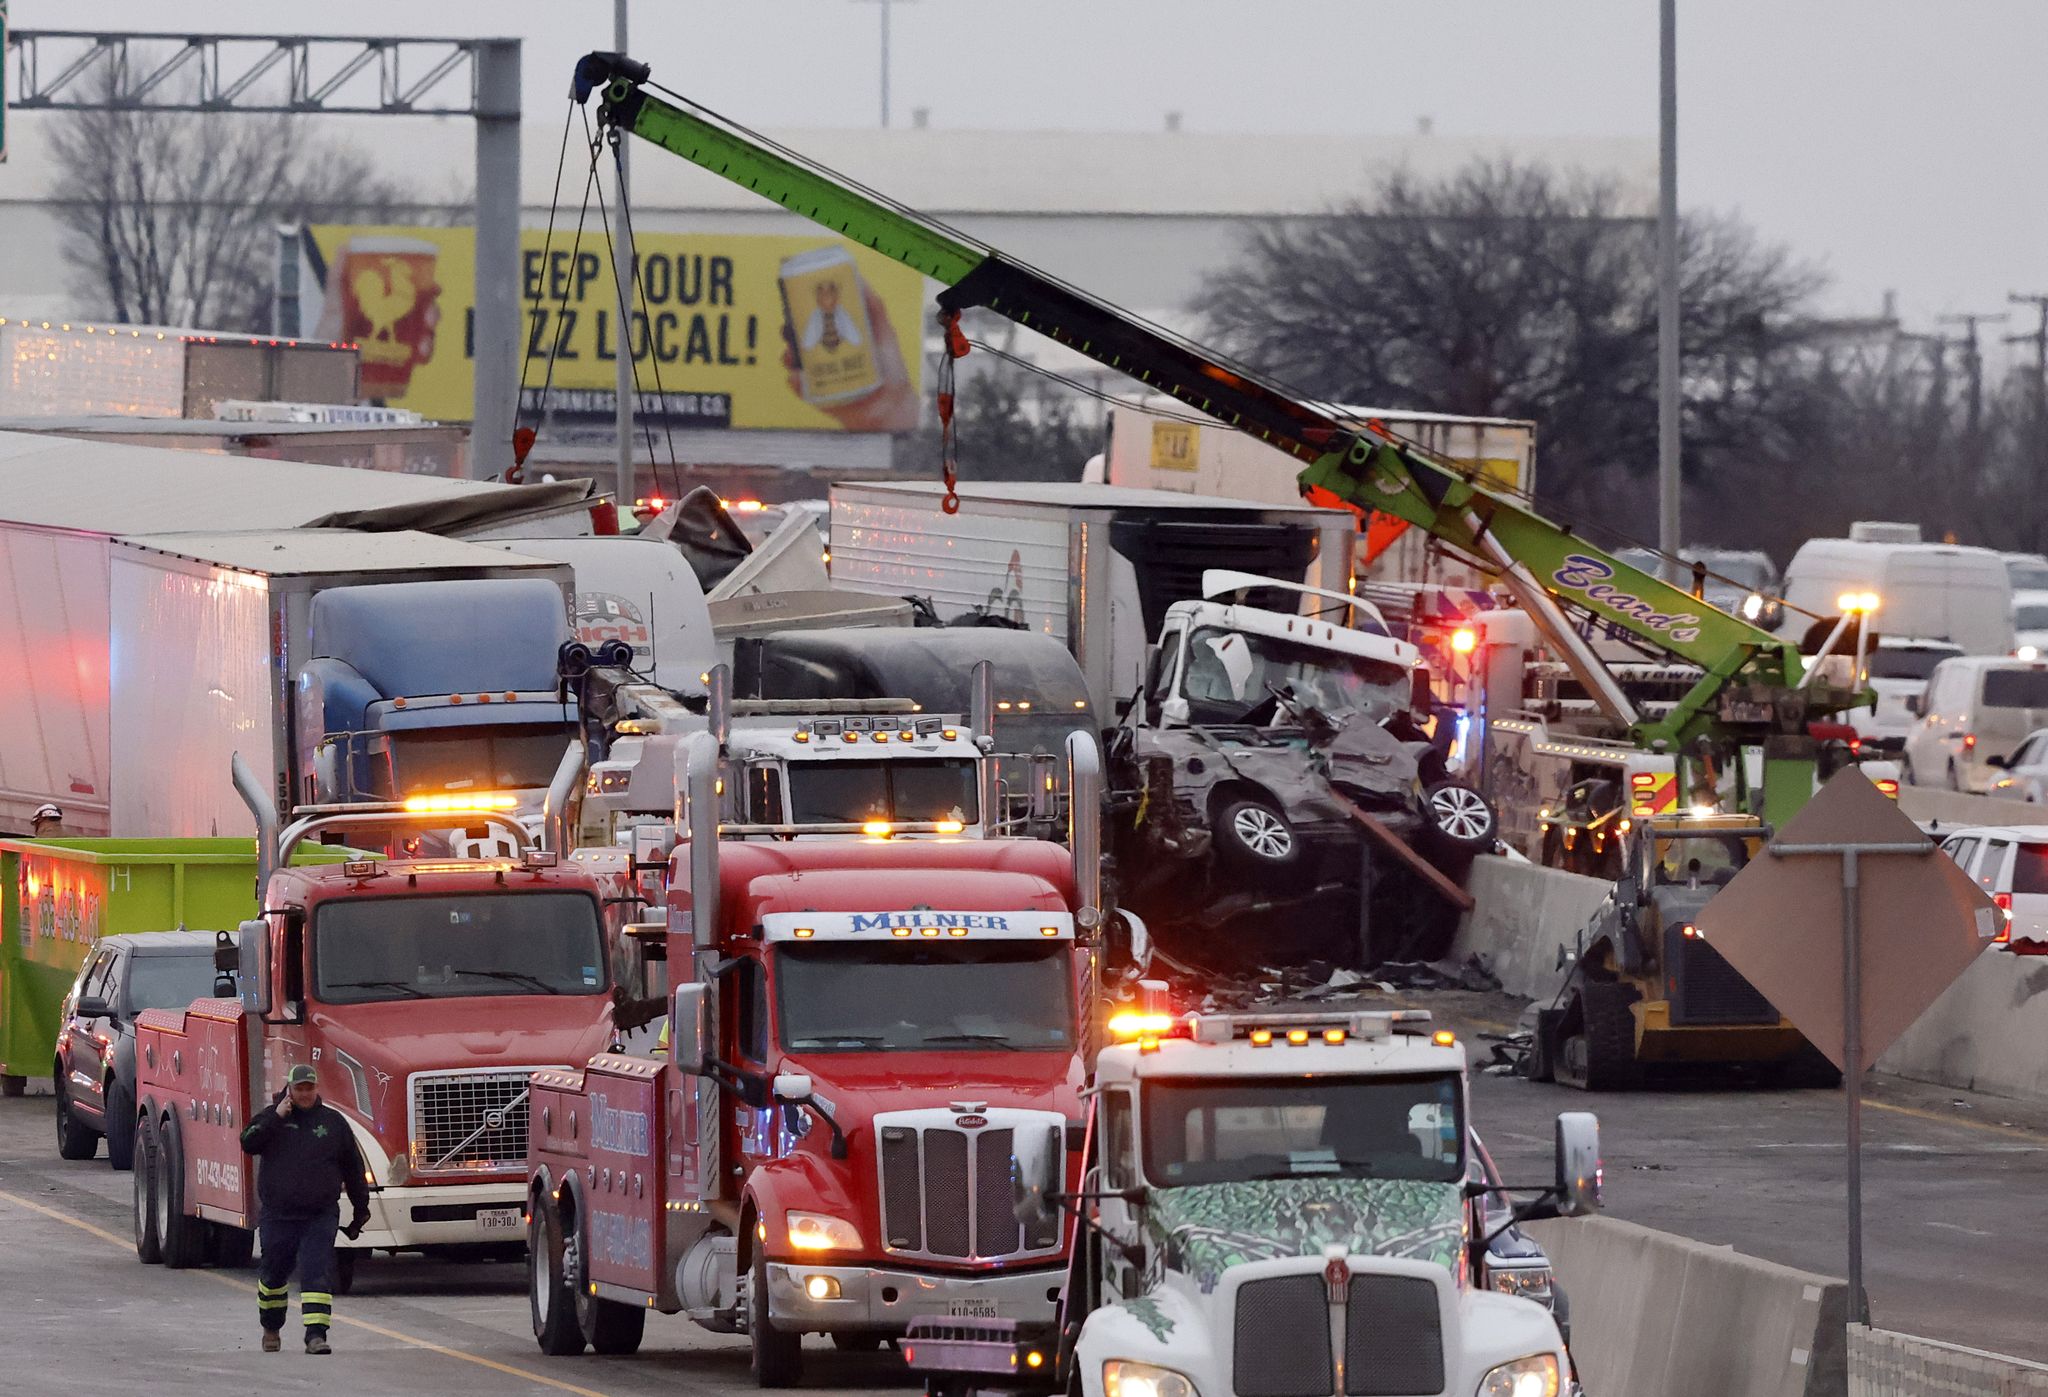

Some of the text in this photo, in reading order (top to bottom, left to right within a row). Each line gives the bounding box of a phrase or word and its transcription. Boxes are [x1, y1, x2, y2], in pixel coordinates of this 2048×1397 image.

[523, 250, 600, 301] EEP
[595, 309, 758, 367] LOCAL!
[1552, 554, 1701, 643] Beard's
[1640, 671, 1706, 681] TOWIN
